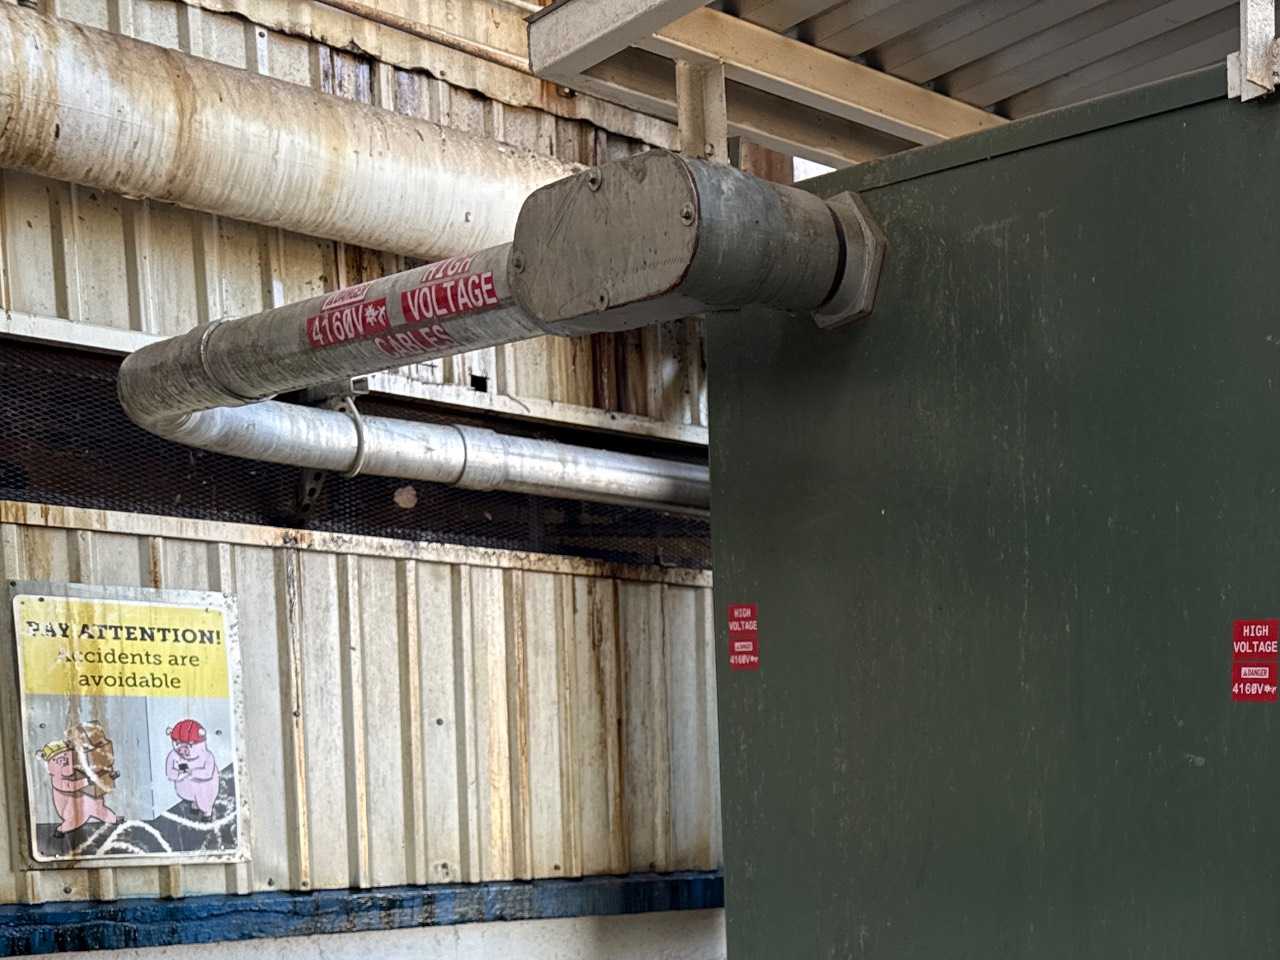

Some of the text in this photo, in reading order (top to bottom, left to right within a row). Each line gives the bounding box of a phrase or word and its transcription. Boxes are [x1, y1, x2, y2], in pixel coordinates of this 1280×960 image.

[407, 271, 498, 321] VOLTAGE
[78, 623, 222, 645] ATTENTION!
[1243, 625, 1269, 636] HIGH
[1233, 640, 1279, 653] VOLTAGE
[168, 653, 201, 668] are
[78, 671, 182, 689] avoidable
